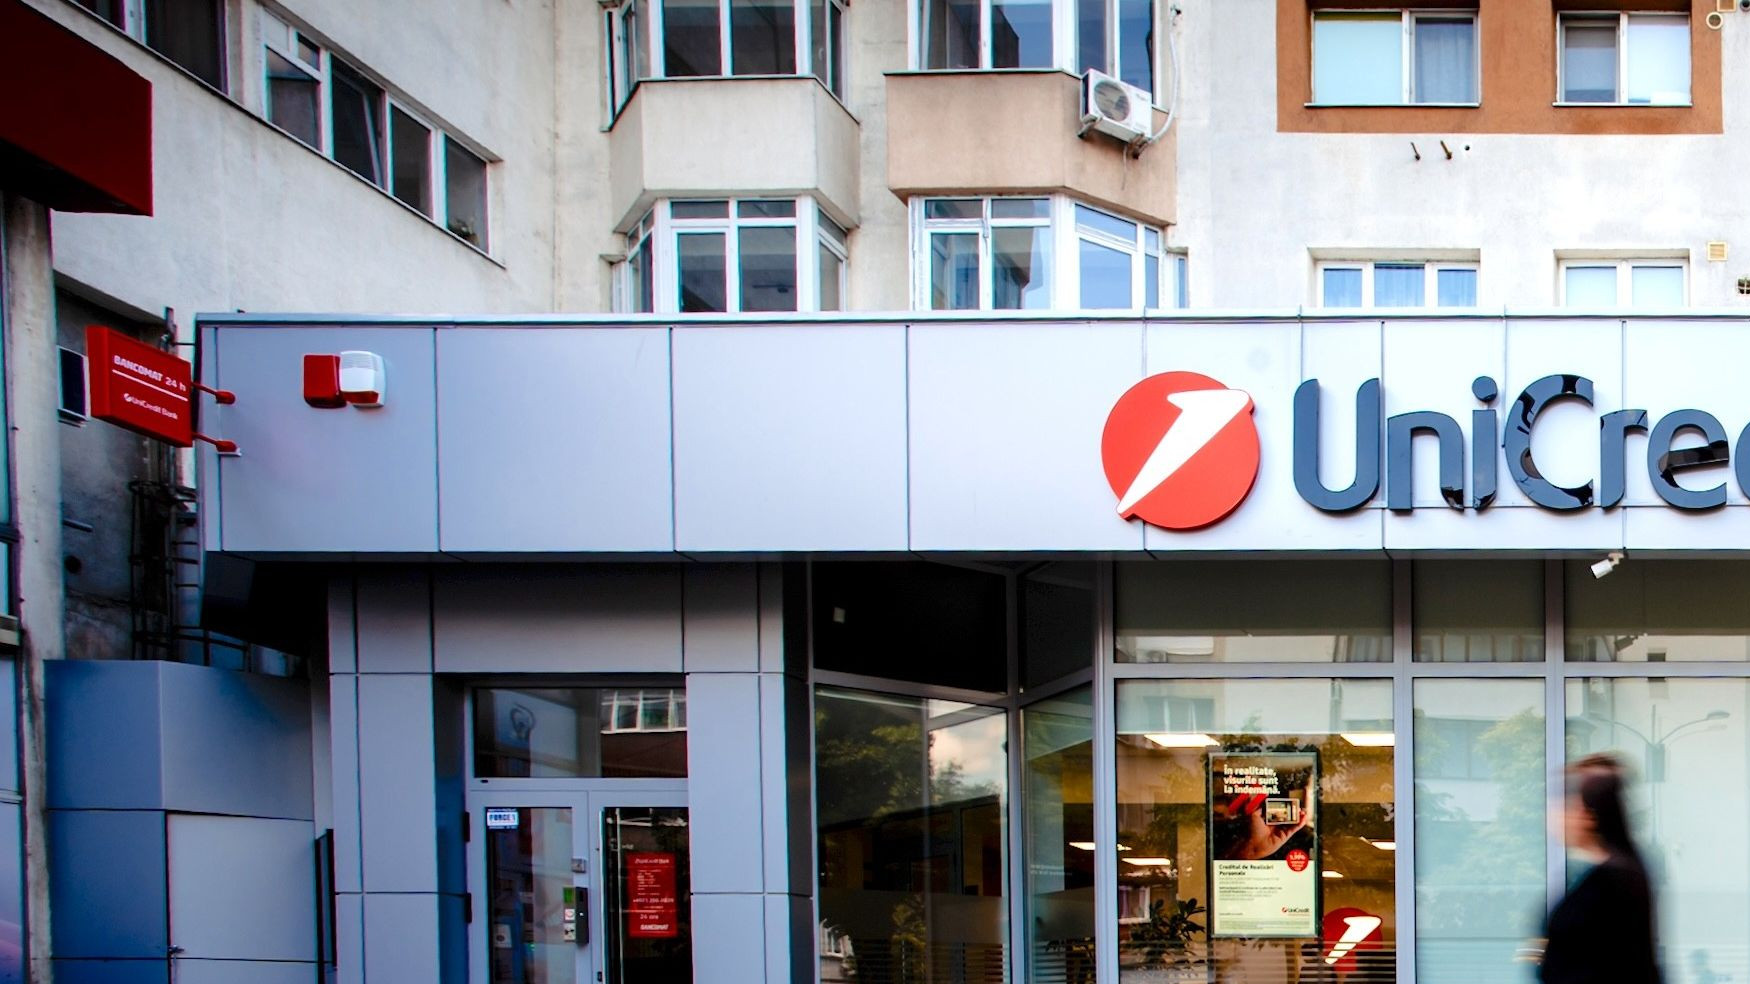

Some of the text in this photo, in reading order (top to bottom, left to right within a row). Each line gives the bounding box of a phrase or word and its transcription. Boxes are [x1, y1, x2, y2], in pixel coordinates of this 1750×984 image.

[114, 355, 186, 391] BANCOMAT 24 h
[131, 397, 178, 420] UniCredit Bank
[1235, 766, 1277, 777] realitate,
[1223, 775, 1278, 785] visurile sunt
[1223, 785, 1233, 794] la
